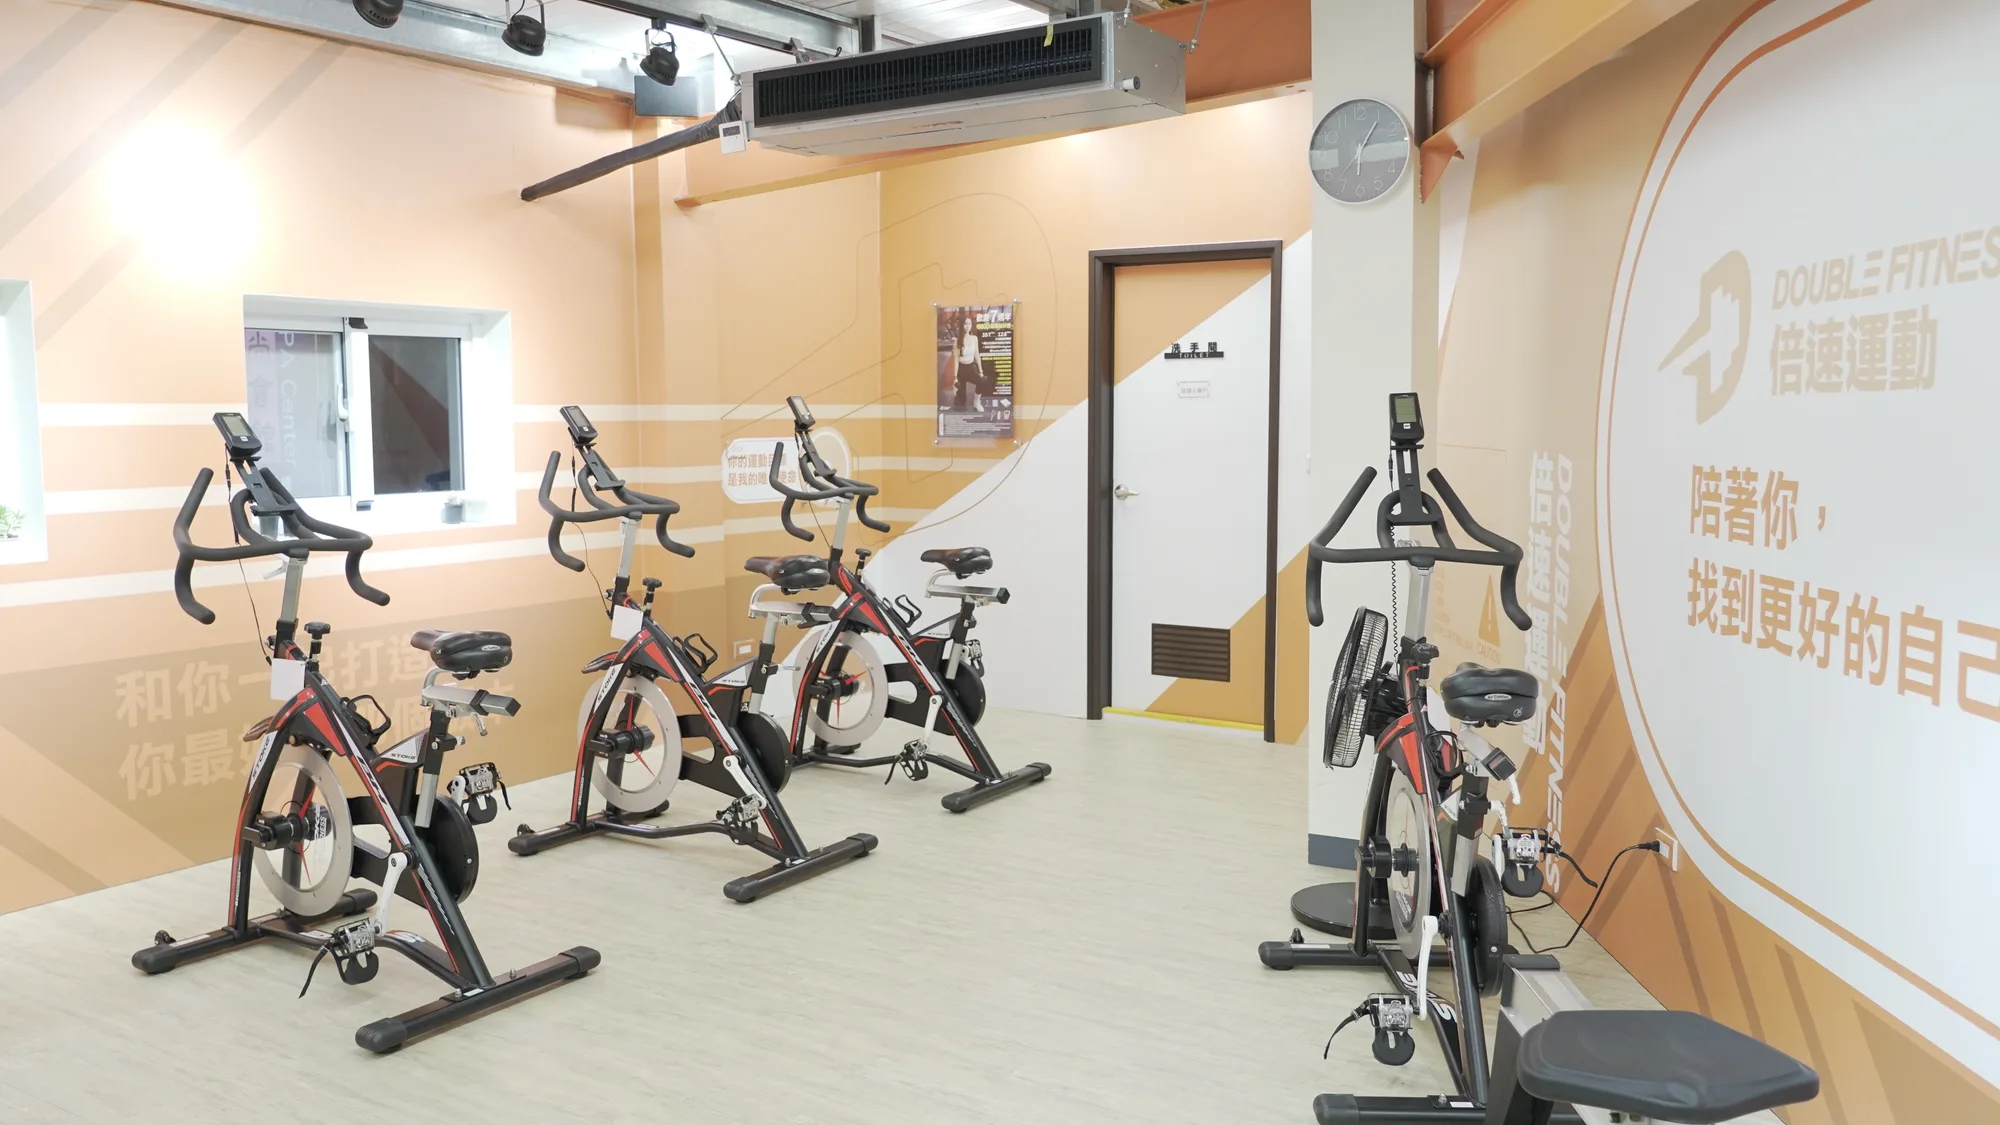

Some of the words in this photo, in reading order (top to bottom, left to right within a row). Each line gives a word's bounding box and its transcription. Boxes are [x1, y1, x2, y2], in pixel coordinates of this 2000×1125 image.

[1771, 249, 1884, 310] DOUBLE
[1171, 342, 1217, 353] 洗手間
[1769, 304, 1939, 396] 倍速運動
[728, 470, 797, 487] 是我的唯使命
[1550, 453, 1573, 677] DOUBLE
[1687, 557, 2000, 723] 找到更好的自己
[252, 735, 271, 778] STOKE
